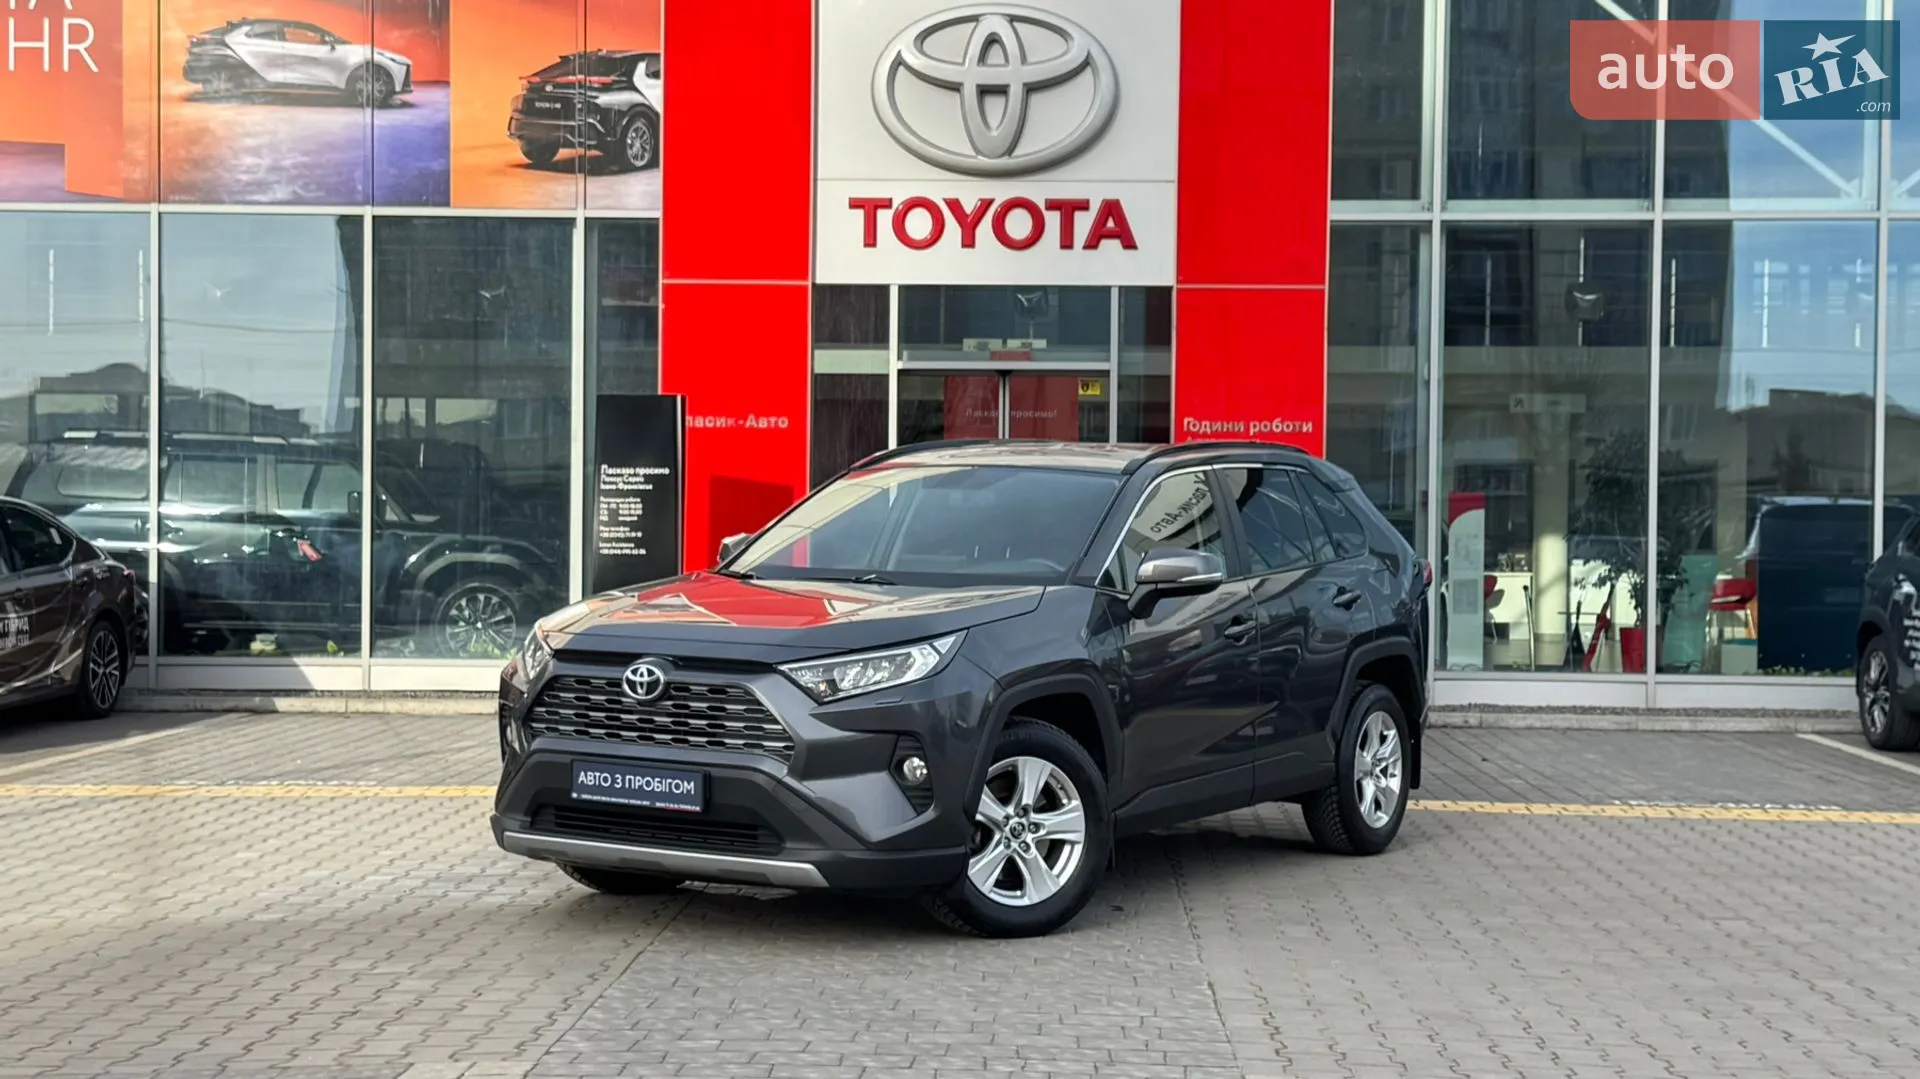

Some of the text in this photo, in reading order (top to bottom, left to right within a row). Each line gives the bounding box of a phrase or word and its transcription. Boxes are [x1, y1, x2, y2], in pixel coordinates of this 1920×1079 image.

[848, 196, 1139, 251] TOYOTA
[685, 413, 789, 429] ласик-Авто
[1183, 417, 1313, 436] Години роботи
[578, 771, 695, 795] АВТО З ПРОБІГОМ
